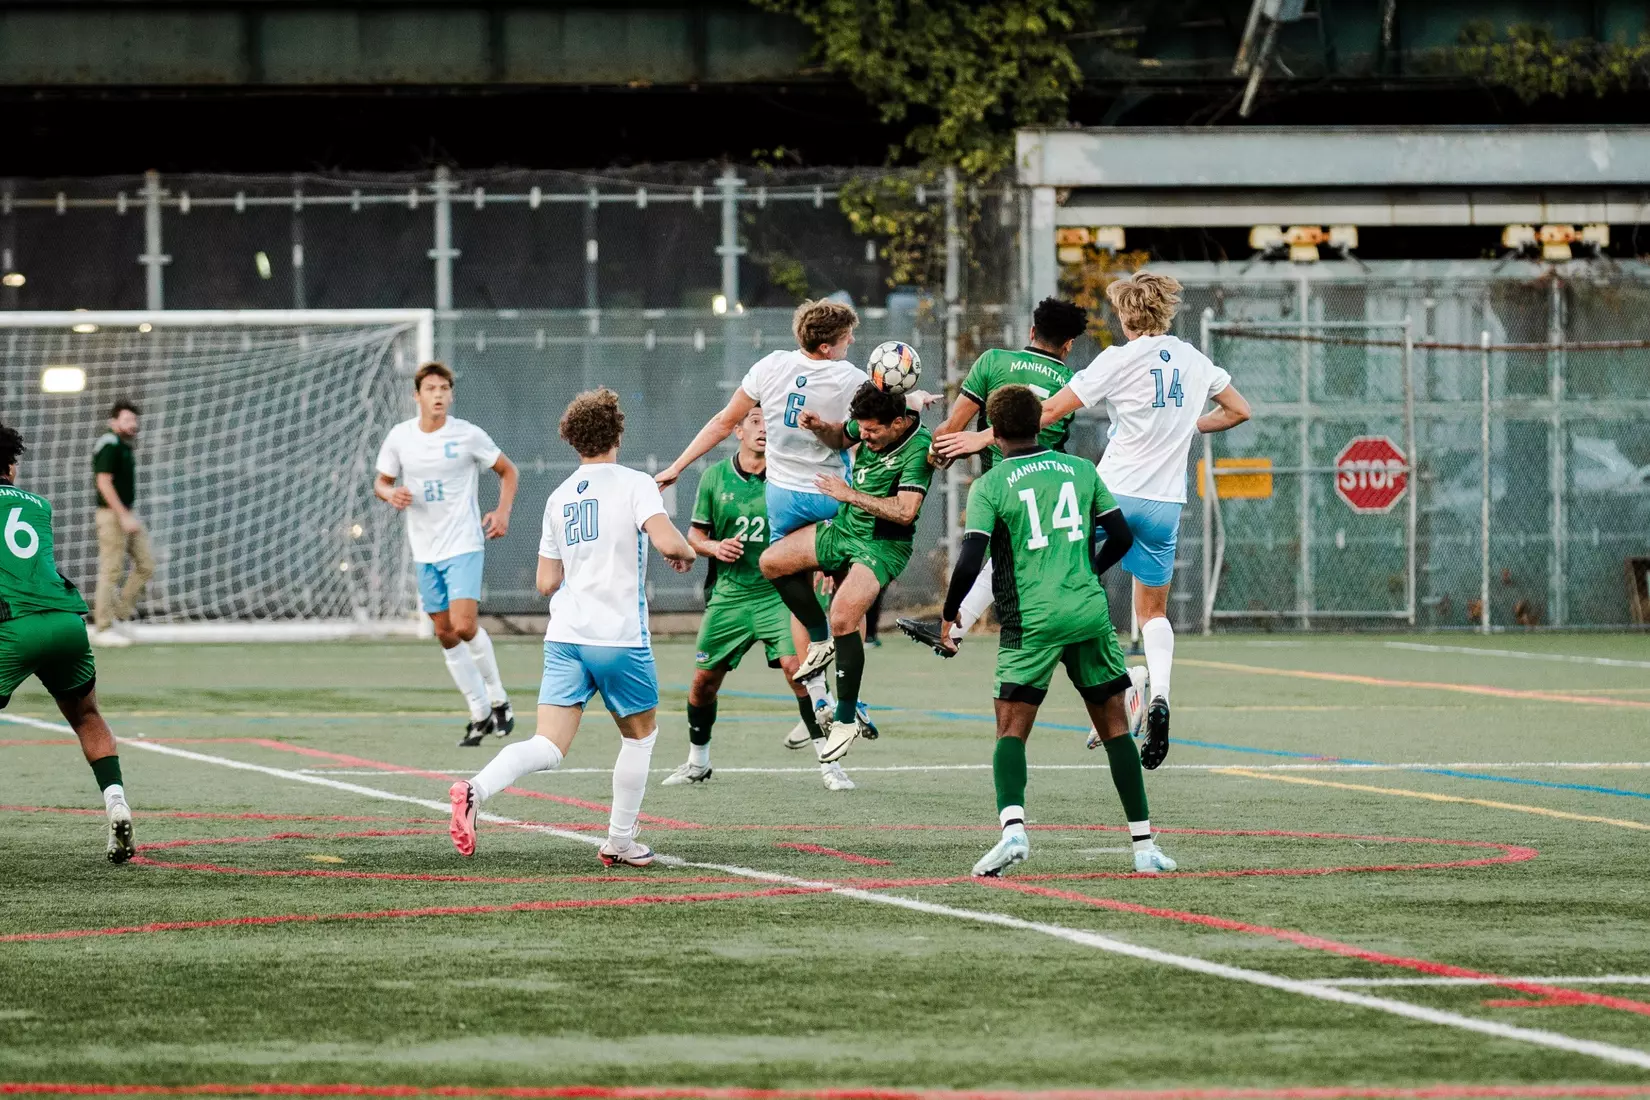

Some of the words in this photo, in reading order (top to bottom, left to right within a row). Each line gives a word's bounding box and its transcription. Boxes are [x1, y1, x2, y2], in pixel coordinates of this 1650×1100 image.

[1150, 368, 1184, 408] 14
[444, 441, 459, 459] C
[1006, 460, 1075, 488] MANHATTAN
[1338, 459, 1404, 491] STOP
[423, 479, 446, 502] 21
[563, 498, 599, 546] 20
[735, 515, 765, 542] 22
[1018, 481, 1084, 551] 14
[4, 507, 39, 559] 6
